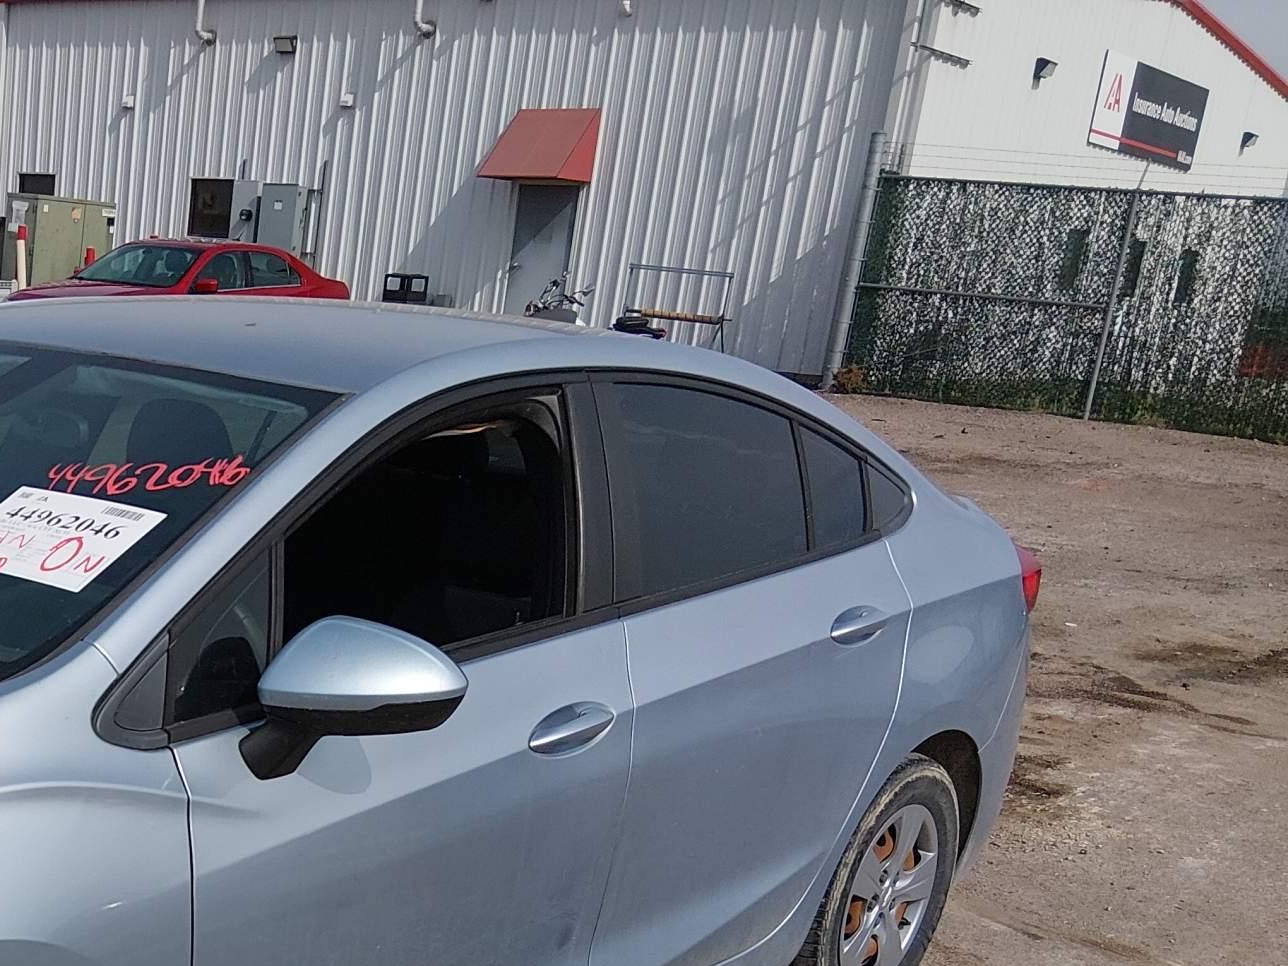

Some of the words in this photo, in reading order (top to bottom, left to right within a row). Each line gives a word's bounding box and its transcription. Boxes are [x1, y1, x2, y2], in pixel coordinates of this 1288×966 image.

[1133, 92, 1161, 119] Insurance
[1160, 102, 1175, 124] Auto
[1173, 107, 1198, 132] Auctions
[6, 506, 127, 539] 44962046
